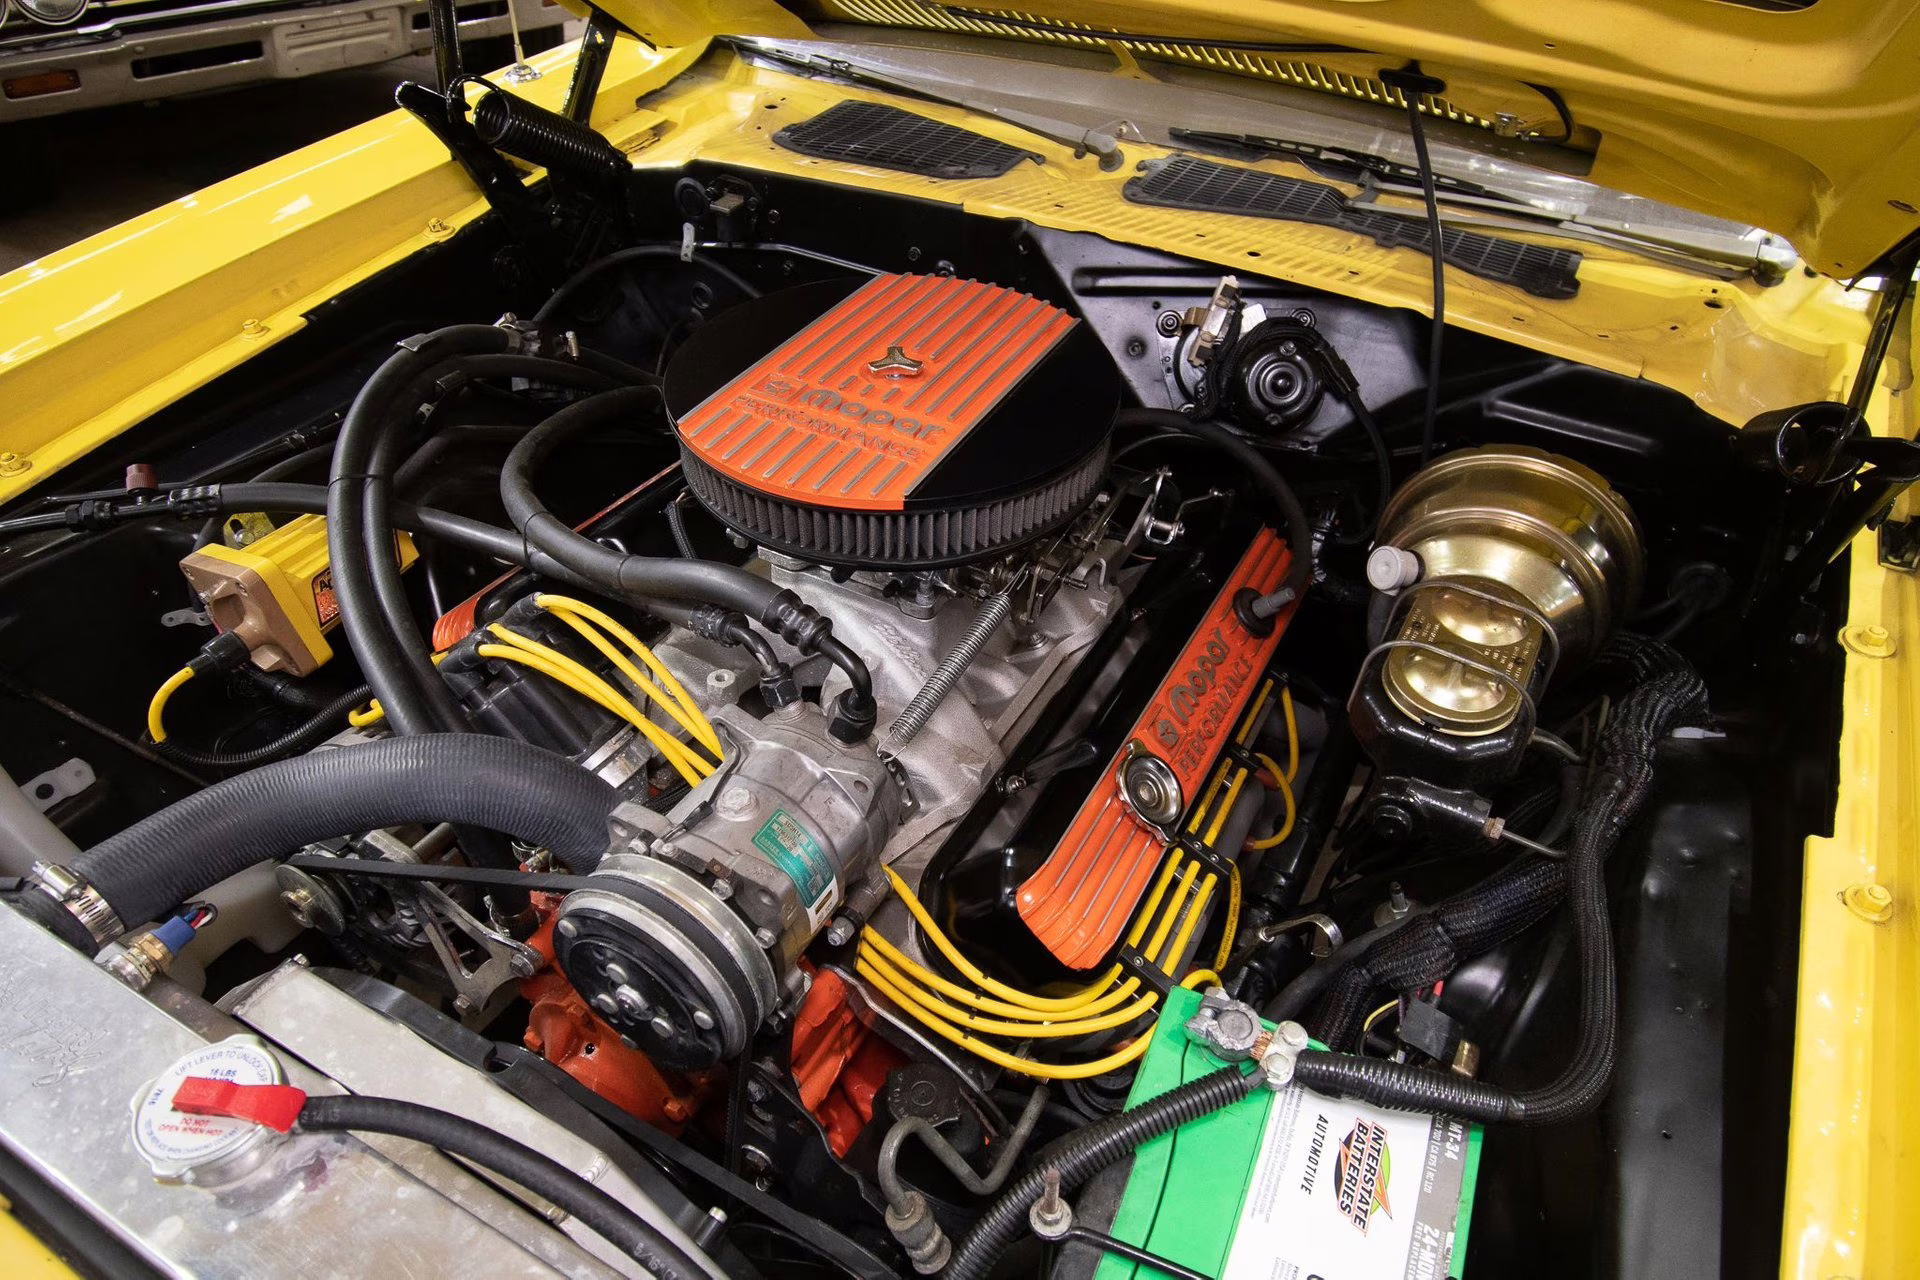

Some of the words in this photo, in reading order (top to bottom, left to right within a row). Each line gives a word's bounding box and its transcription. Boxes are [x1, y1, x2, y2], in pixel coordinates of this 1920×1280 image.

[736, 394, 921, 458] PERFORMANCE
[1178, 655, 1253, 781] PERFORMANCE
[194, 1050, 223, 1065] LEVER
[225, 1050, 237, 1058] TO
[220, 1069, 237, 1077] LBS
[1300, 1114, 1329, 1195] AUTOMOTIVE
[1433, 1127, 1442, 1141] 700
[1446, 1120, 1464, 1160] MT-34
[1340, 1122, 1368, 1214] BATTERIES
[1353, 1126, 1385, 1229] INTERSTATE
[1424, 1181, 1434, 1194] 120
